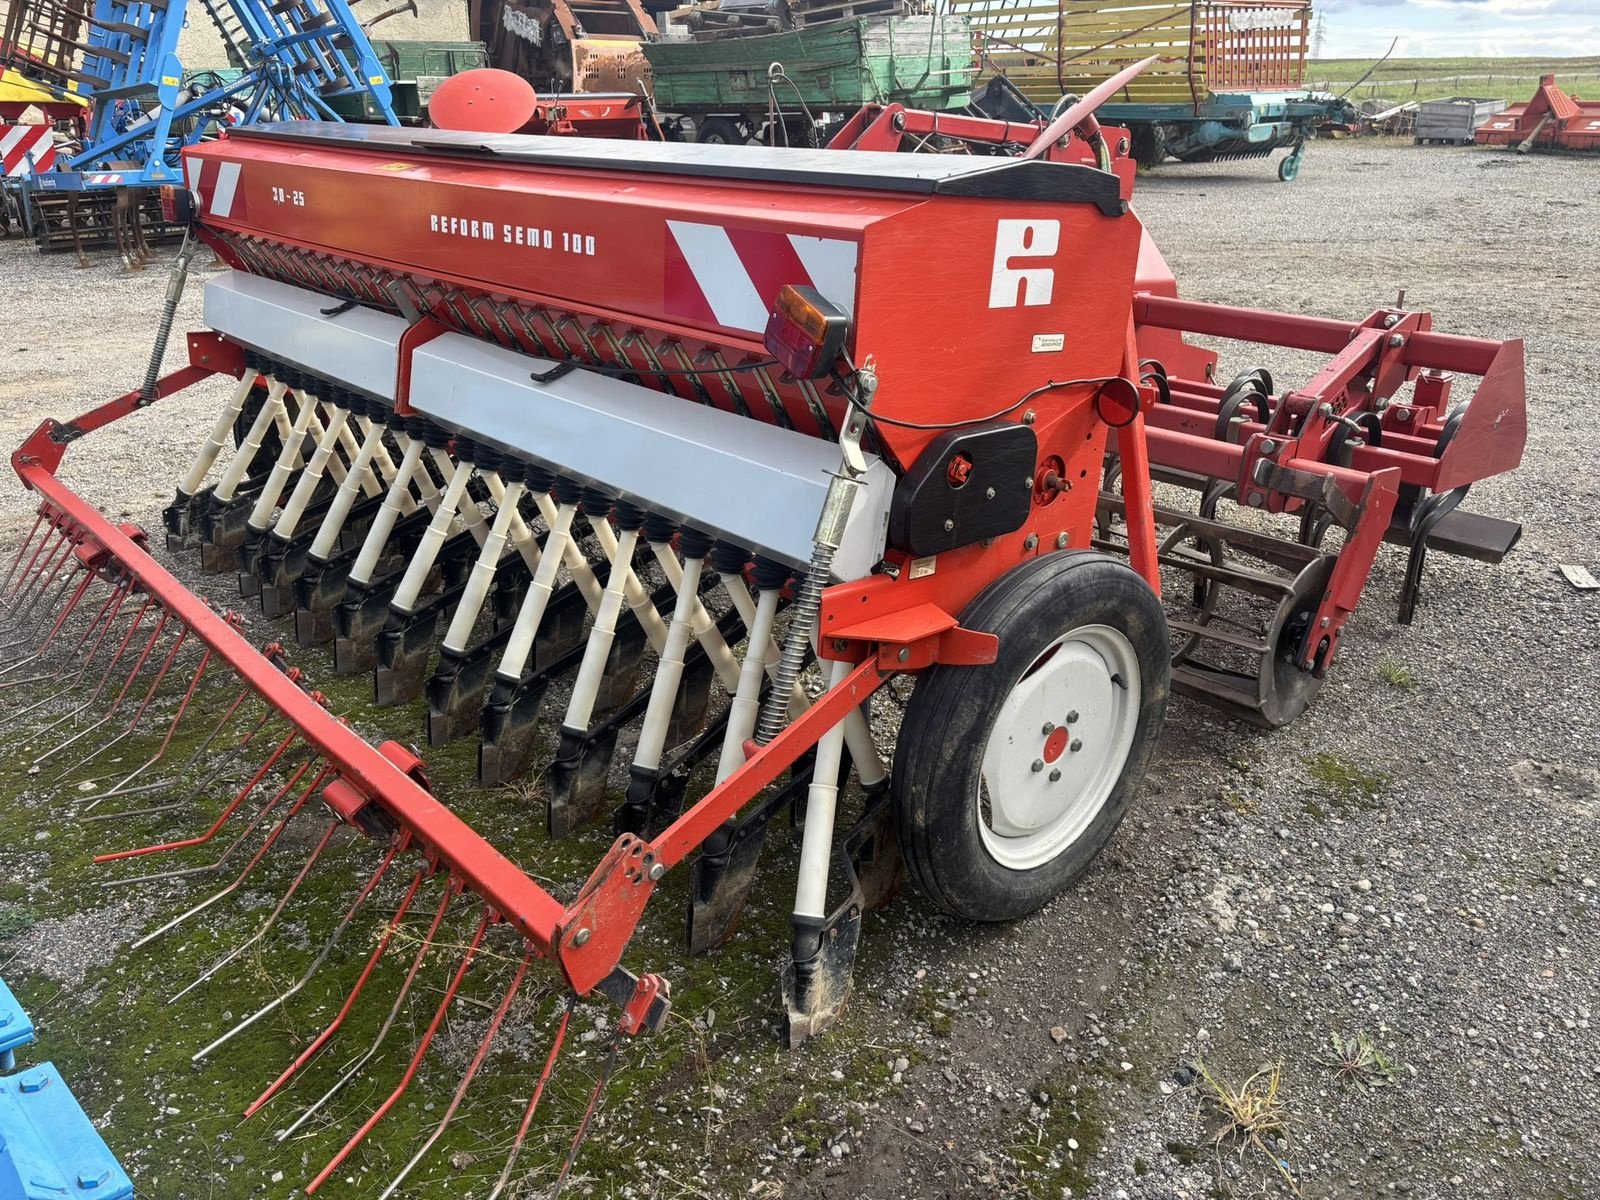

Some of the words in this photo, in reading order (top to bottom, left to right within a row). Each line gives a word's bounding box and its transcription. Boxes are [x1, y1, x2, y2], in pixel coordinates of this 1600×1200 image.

[430, 214, 494, 240] REFORM
[503, 224, 552, 249] SEMO
[562, 232, 595, 256] 100
